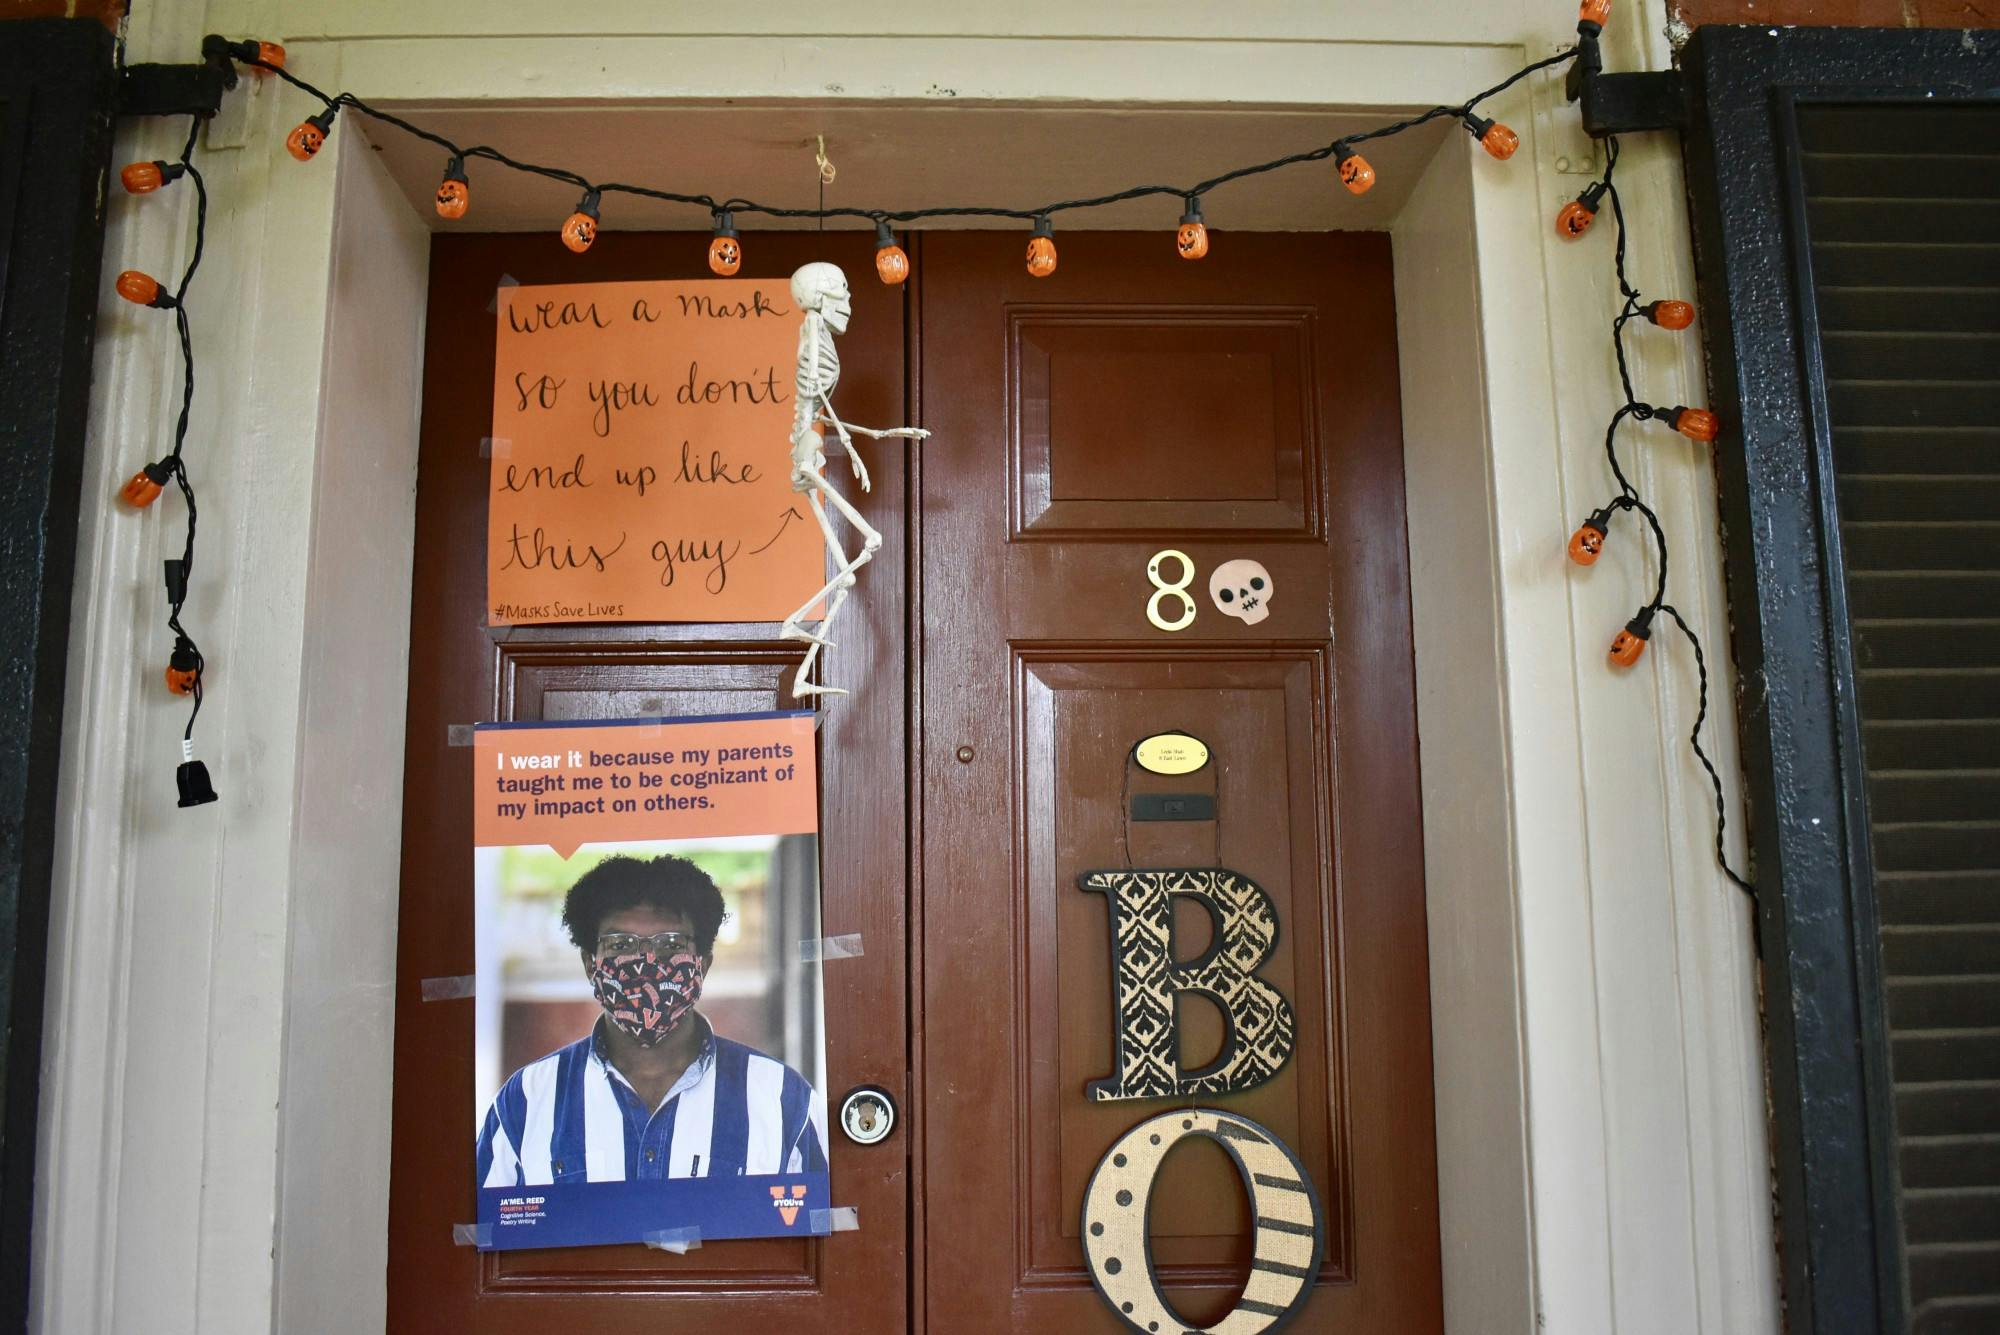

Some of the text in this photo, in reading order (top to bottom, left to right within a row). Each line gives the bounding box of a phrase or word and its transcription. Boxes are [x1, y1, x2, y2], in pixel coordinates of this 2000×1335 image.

[509, 300, 612, 333] wear
[632, 298, 661, 323] a
[515, 361, 790, 437] so you don't
[498, 440, 763, 496] end up like
[500, 523, 741, 595] this guy
[1146, 549, 1197, 632] 8
[497, 742, 794, 770] I wear it because my parents
[497, 764, 796, 796] taught me to be cognizant of
[497, 793, 716, 819] my impact on others.
[500, 1196, 545, 1206] JA'MEL REED
